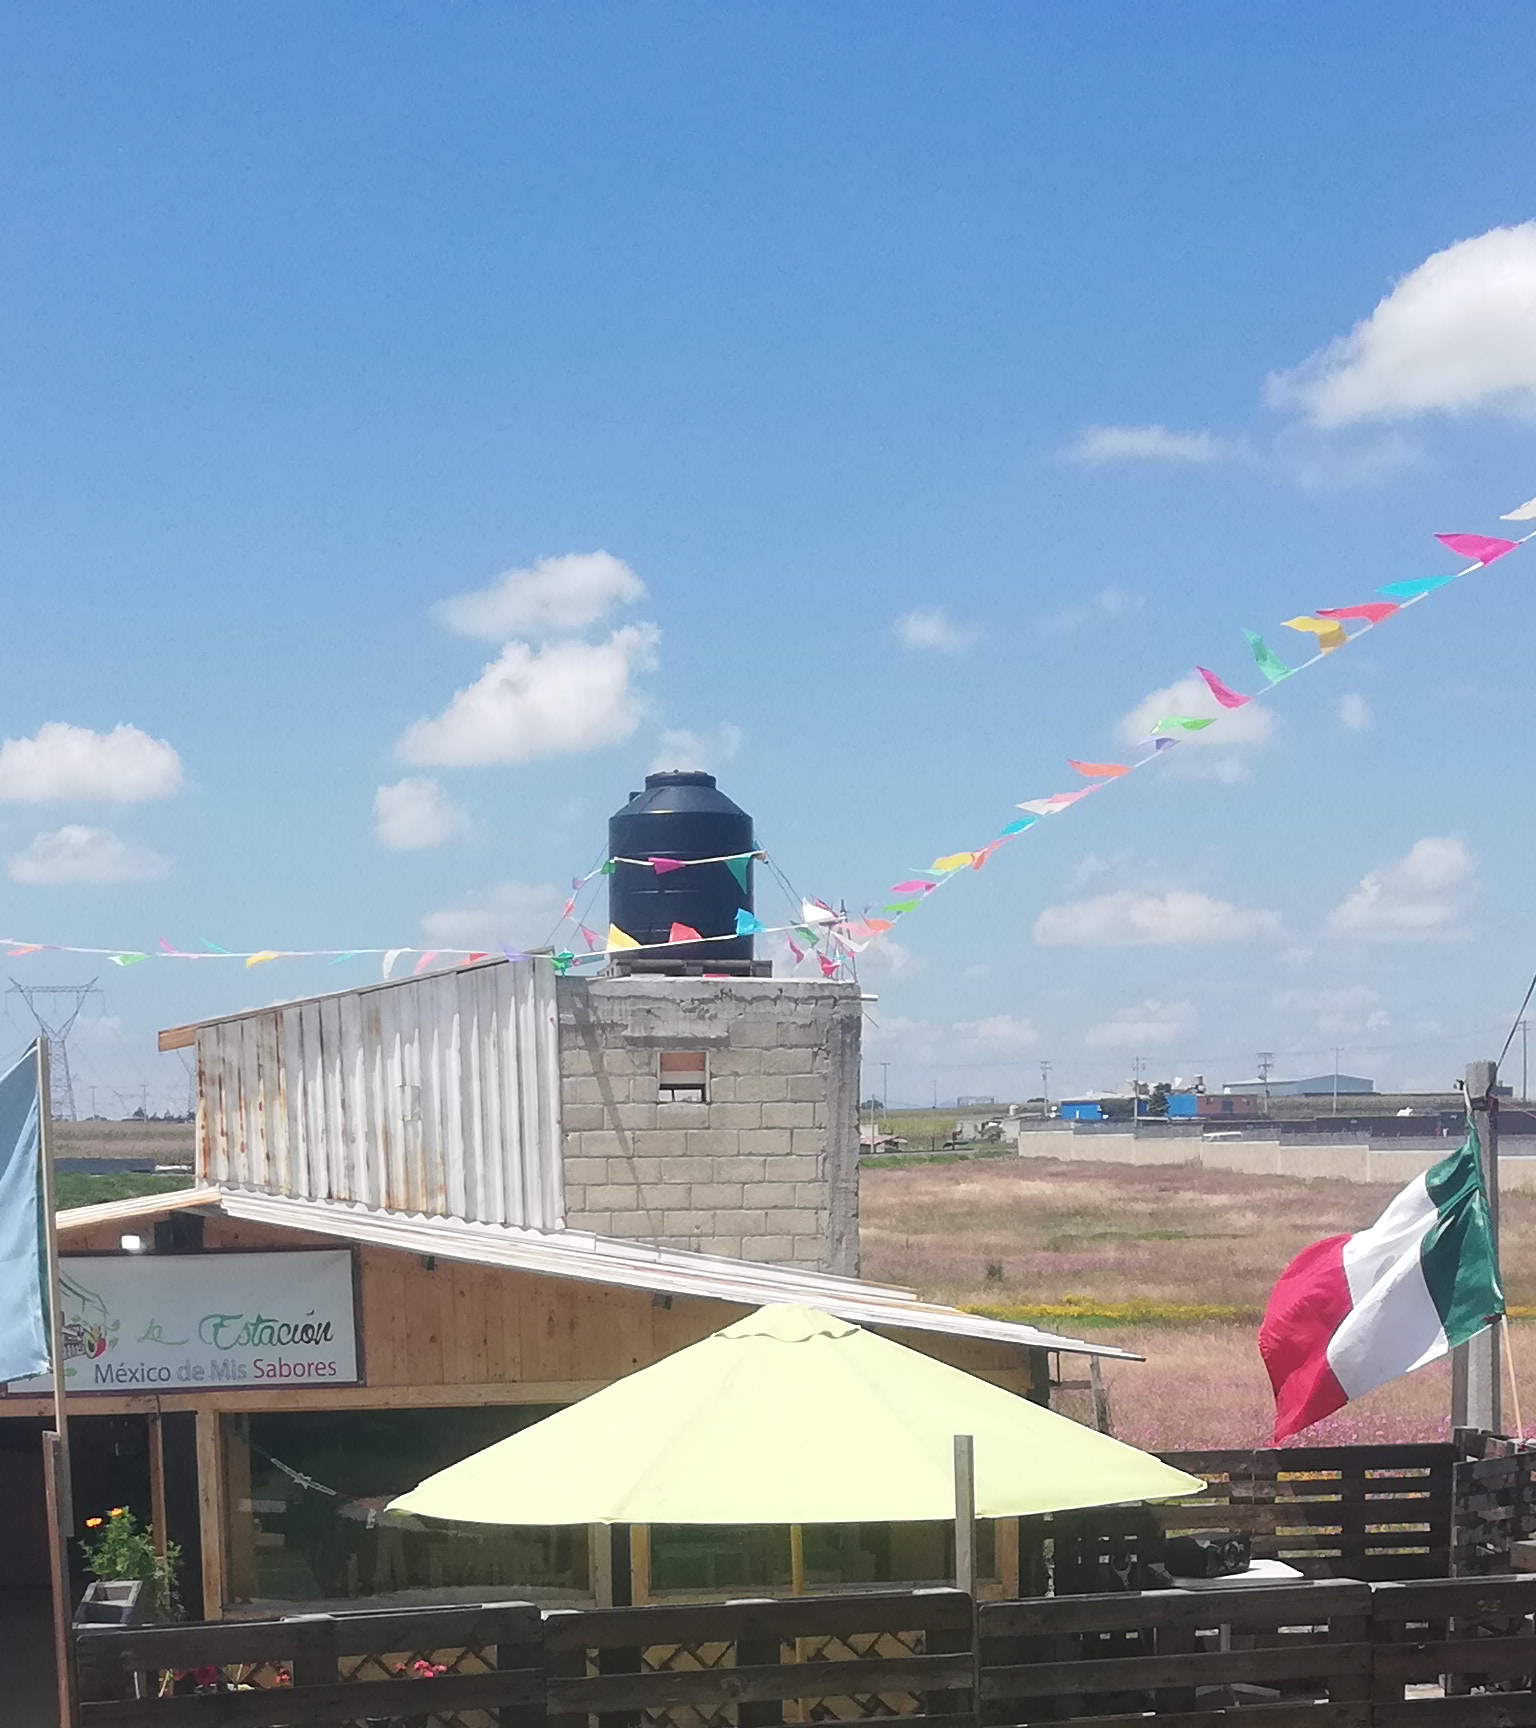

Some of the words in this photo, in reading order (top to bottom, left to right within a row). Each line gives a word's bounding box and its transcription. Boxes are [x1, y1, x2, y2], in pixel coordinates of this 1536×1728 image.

[198, 1309, 334, 1350] Estación
[95, 1361, 171, 1384] México
[177, 1359, 206, 1382] de
[210, 1360, 248, 1381] Mis
[253, 1357, 337, 1379] Sabores
